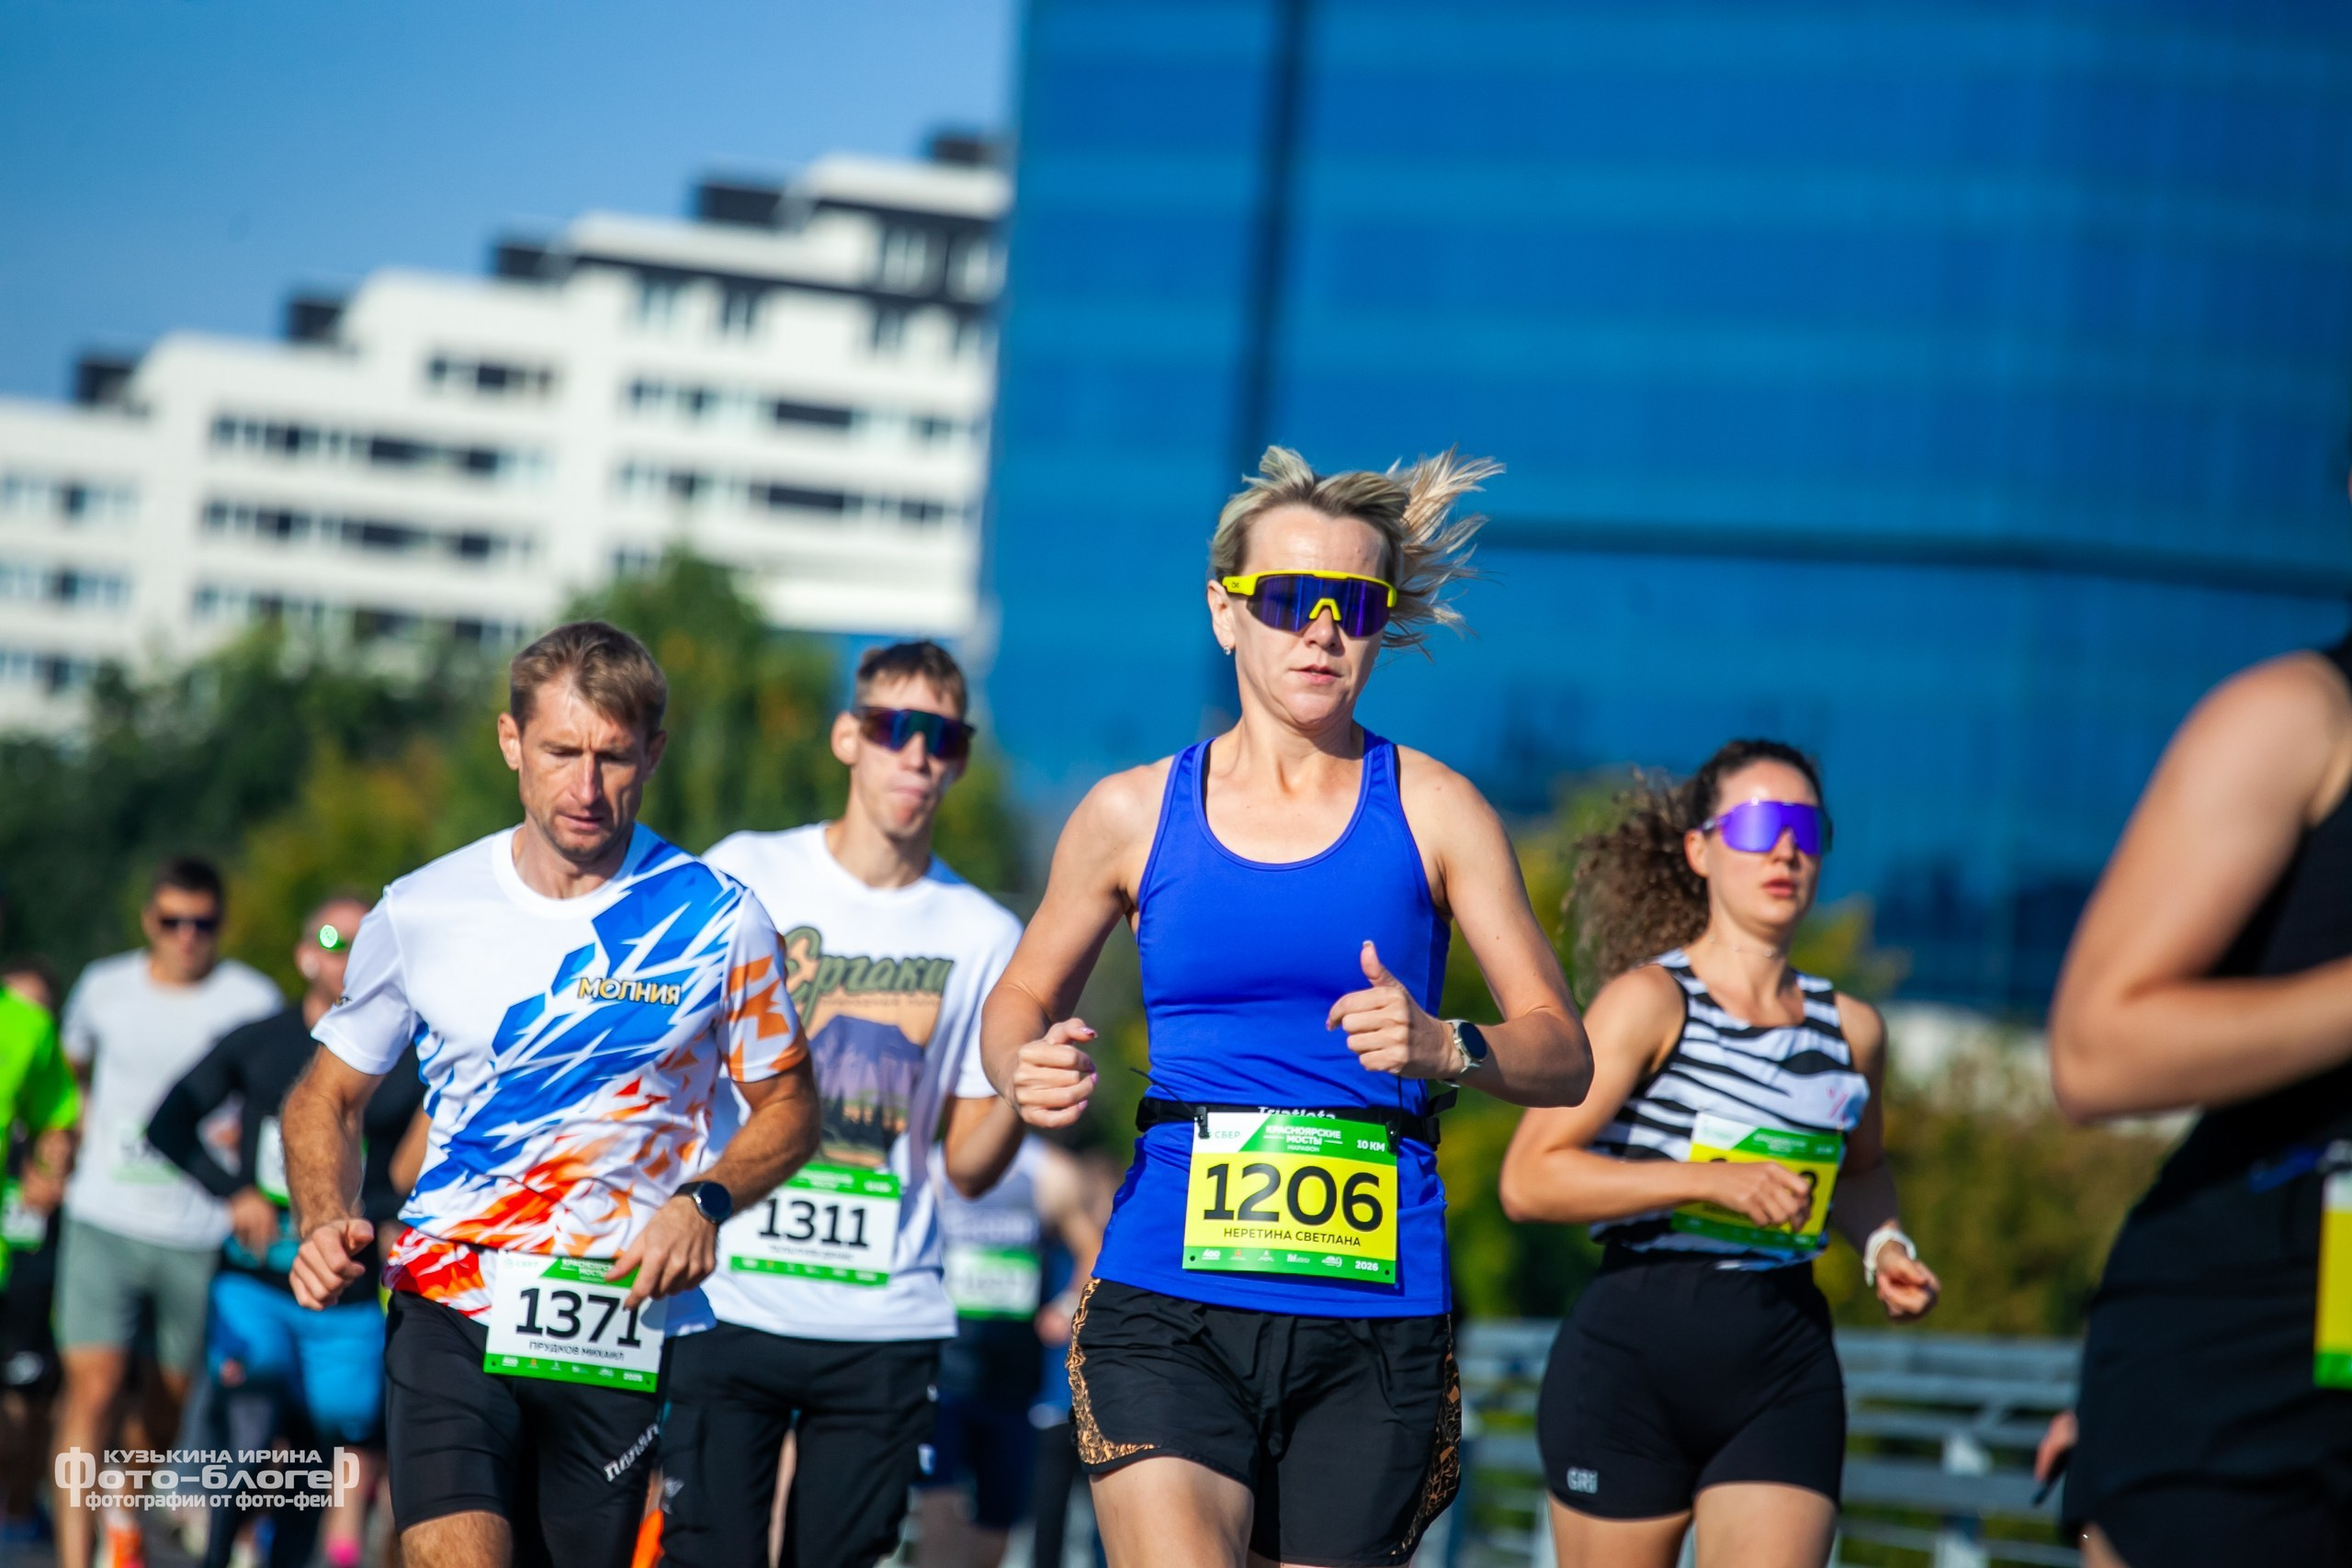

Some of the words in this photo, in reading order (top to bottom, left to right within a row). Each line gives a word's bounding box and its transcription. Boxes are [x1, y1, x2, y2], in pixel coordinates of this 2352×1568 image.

[577, 976, 682, 1006] МОЛНИЯ
[1215, 1131, 1240, 1139] СБЕР
[1265, 1125, 1341, 1139] КРАСНОЯРСКИЕ
[1286, 1135, 1322, 1145] МОСТЫ
[1357, 1140, 1368, 1150] 10
[1204, 1163, 1383, 1232] 1206
[759, 1197, 869, 1248] 1311
[1224, 1228, 1292, 1240] НЕРЕТИНА
[1295, 1231, 1361, 1247] СВЕТЛАНА
[1355, 1260, 1378, 1272] 2026
[515, 1288, 641, 1348] 1371
[529, 1341, 580, 1356] ПРУДКОВ
[581, 1348, 625, 1361] МИХАИЛ
